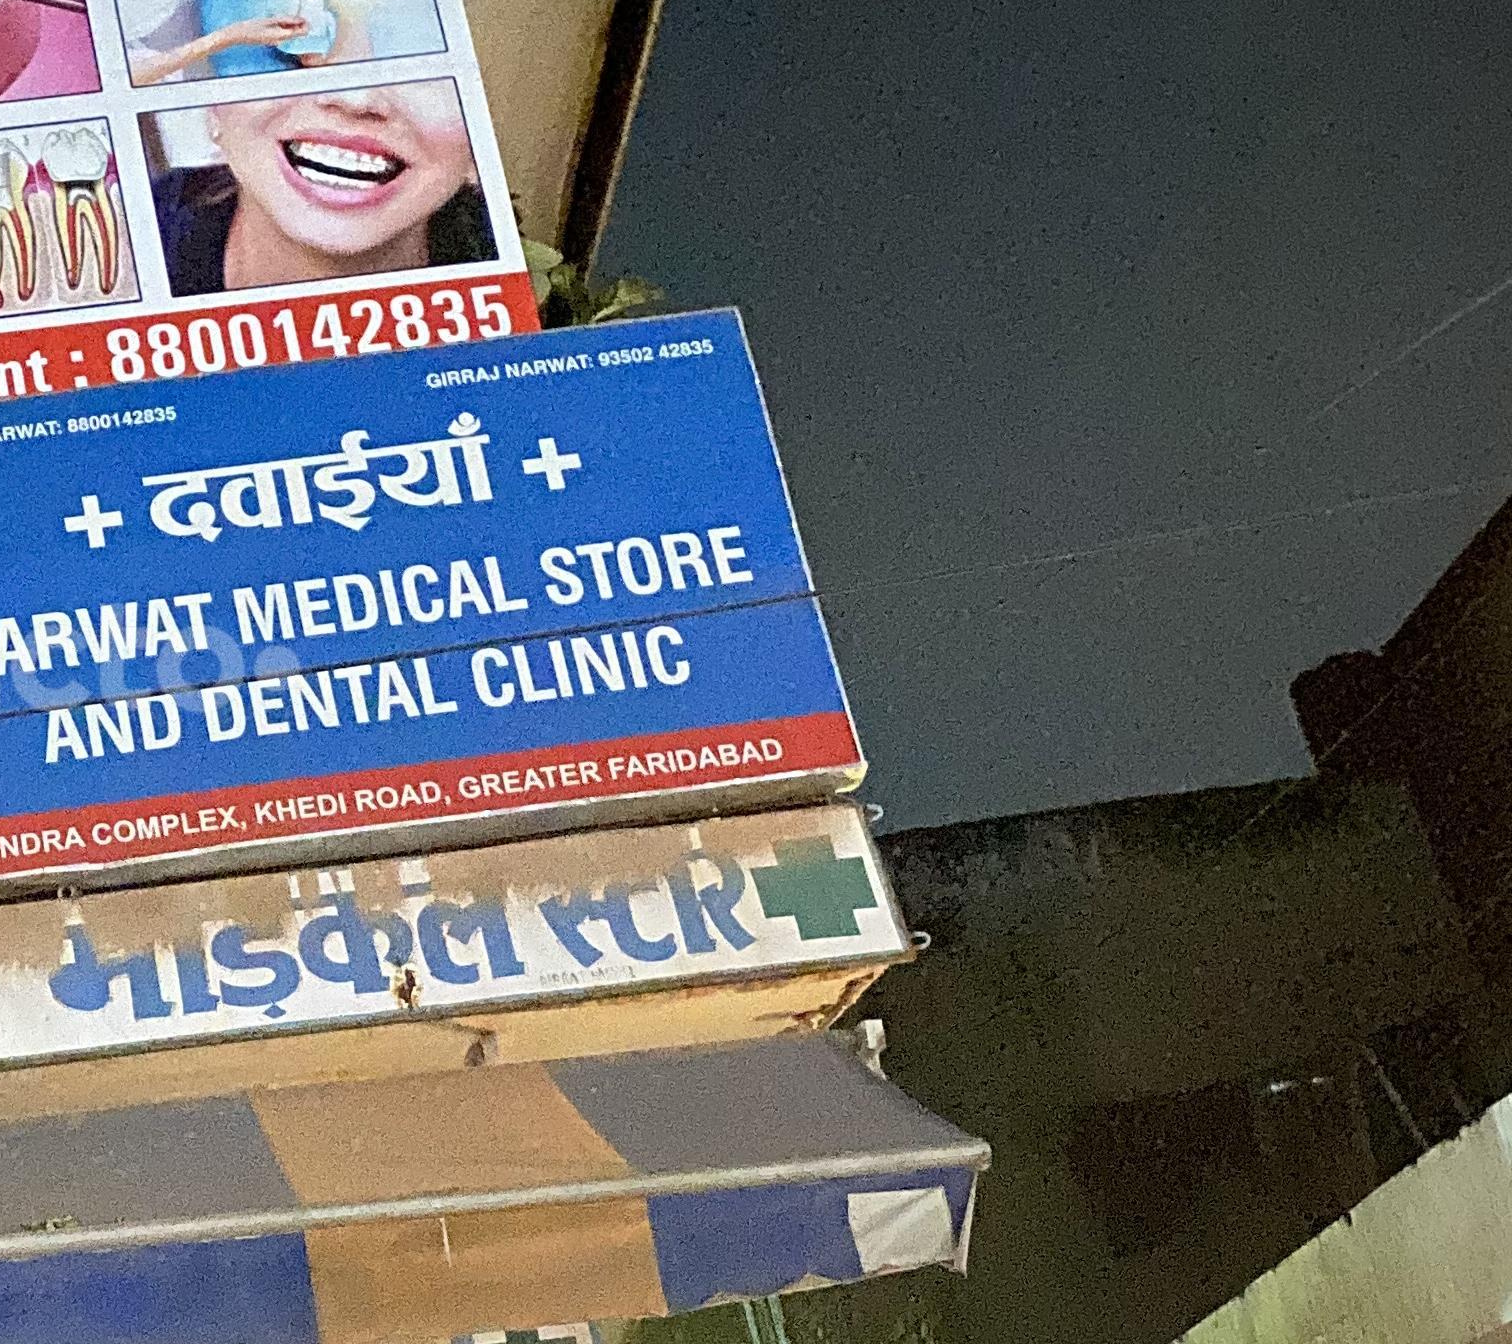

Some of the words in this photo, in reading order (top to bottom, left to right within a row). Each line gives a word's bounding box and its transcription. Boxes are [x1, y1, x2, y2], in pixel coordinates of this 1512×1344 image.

[106, 284, 514, 383] 8800142835
[426, 368, 500, 389] GIRRAJ
[504, 354, 593, 379] NARWAT:
[598, 346, 654, 368] 93502
[658, 339, 714, 360] 42835
[67, 405, 176, 434] 8800142835
[235, 556, 530, 646] MEDICAL
[543, 526, 755, 608] STORE
[43, 693, 183, 763] AND
[204, 654, 459, 746] DENTAL
[473, 625, 693, 704] CLINIC
[91, 805, 249, 846] COMPLEX,
[255, 793, 350, 826] KHEDI
[355, 781, 454, 812] ROAD,
[458, 761, 604, 799] GREATER
[607, 737, 785, 782] FARIDABAD
